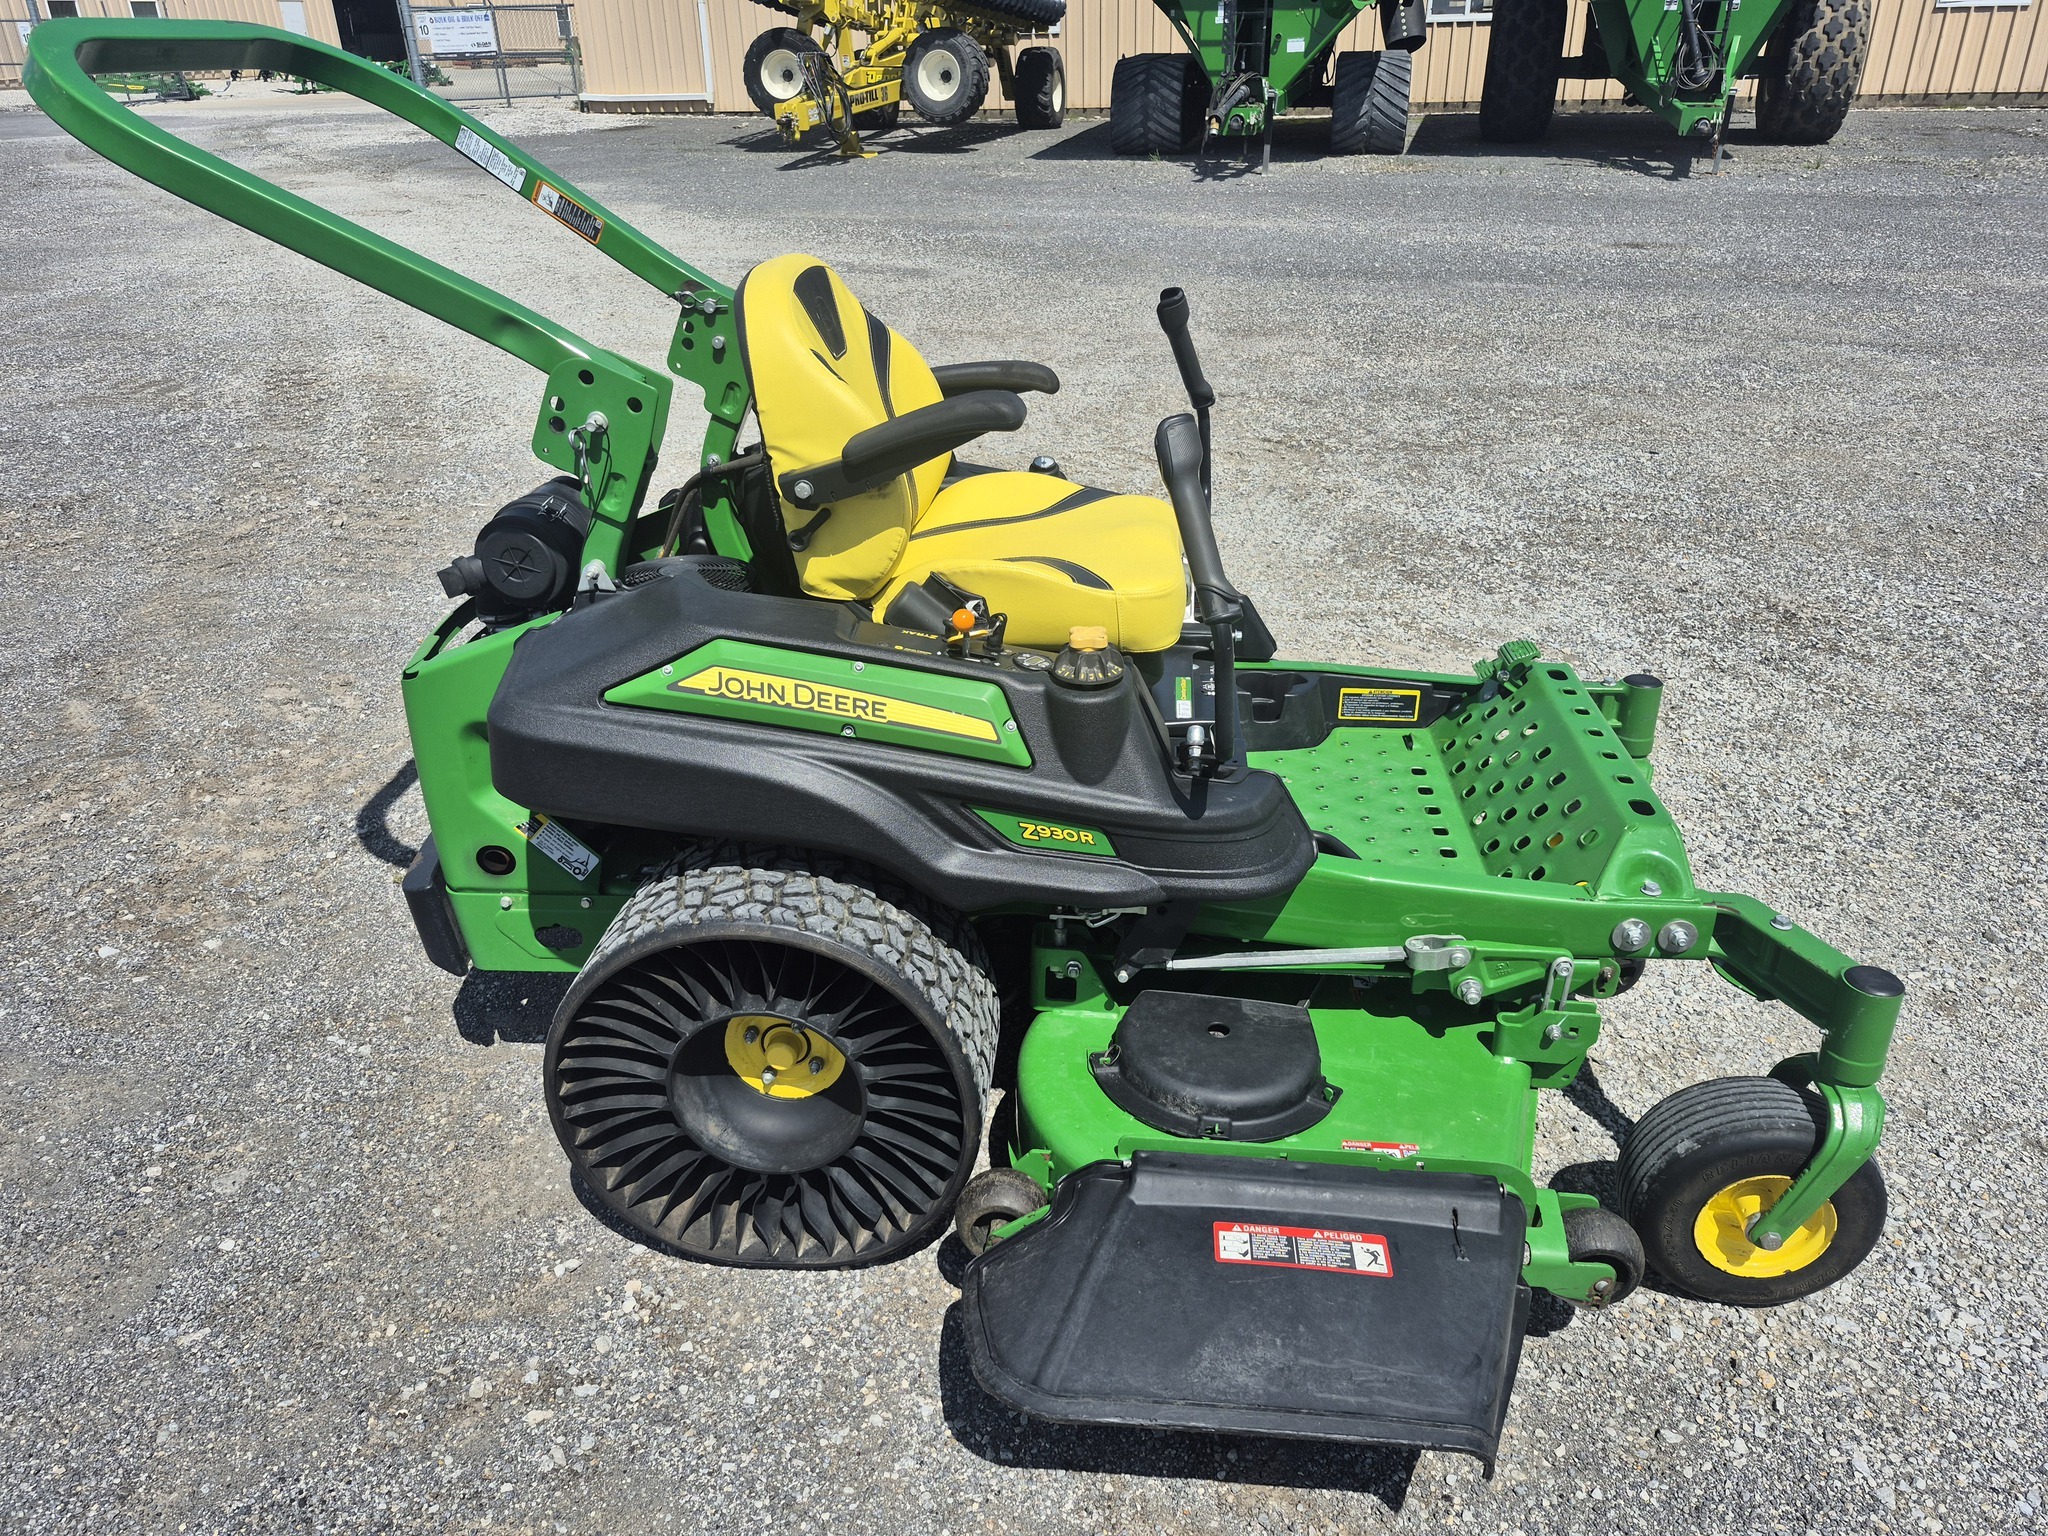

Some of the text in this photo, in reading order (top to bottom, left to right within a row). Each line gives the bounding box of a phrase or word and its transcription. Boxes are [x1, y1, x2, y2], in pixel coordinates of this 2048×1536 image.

[419, 24, 430, 36] 10
[708, 671, 887, 720] JOHN DEERE
[1702, 1152, 1807, 1183] RELIANC
[1243, 1225, 1280, 1234] DANGER
[1323, 1231, 1362, 1241] PELIGRO
